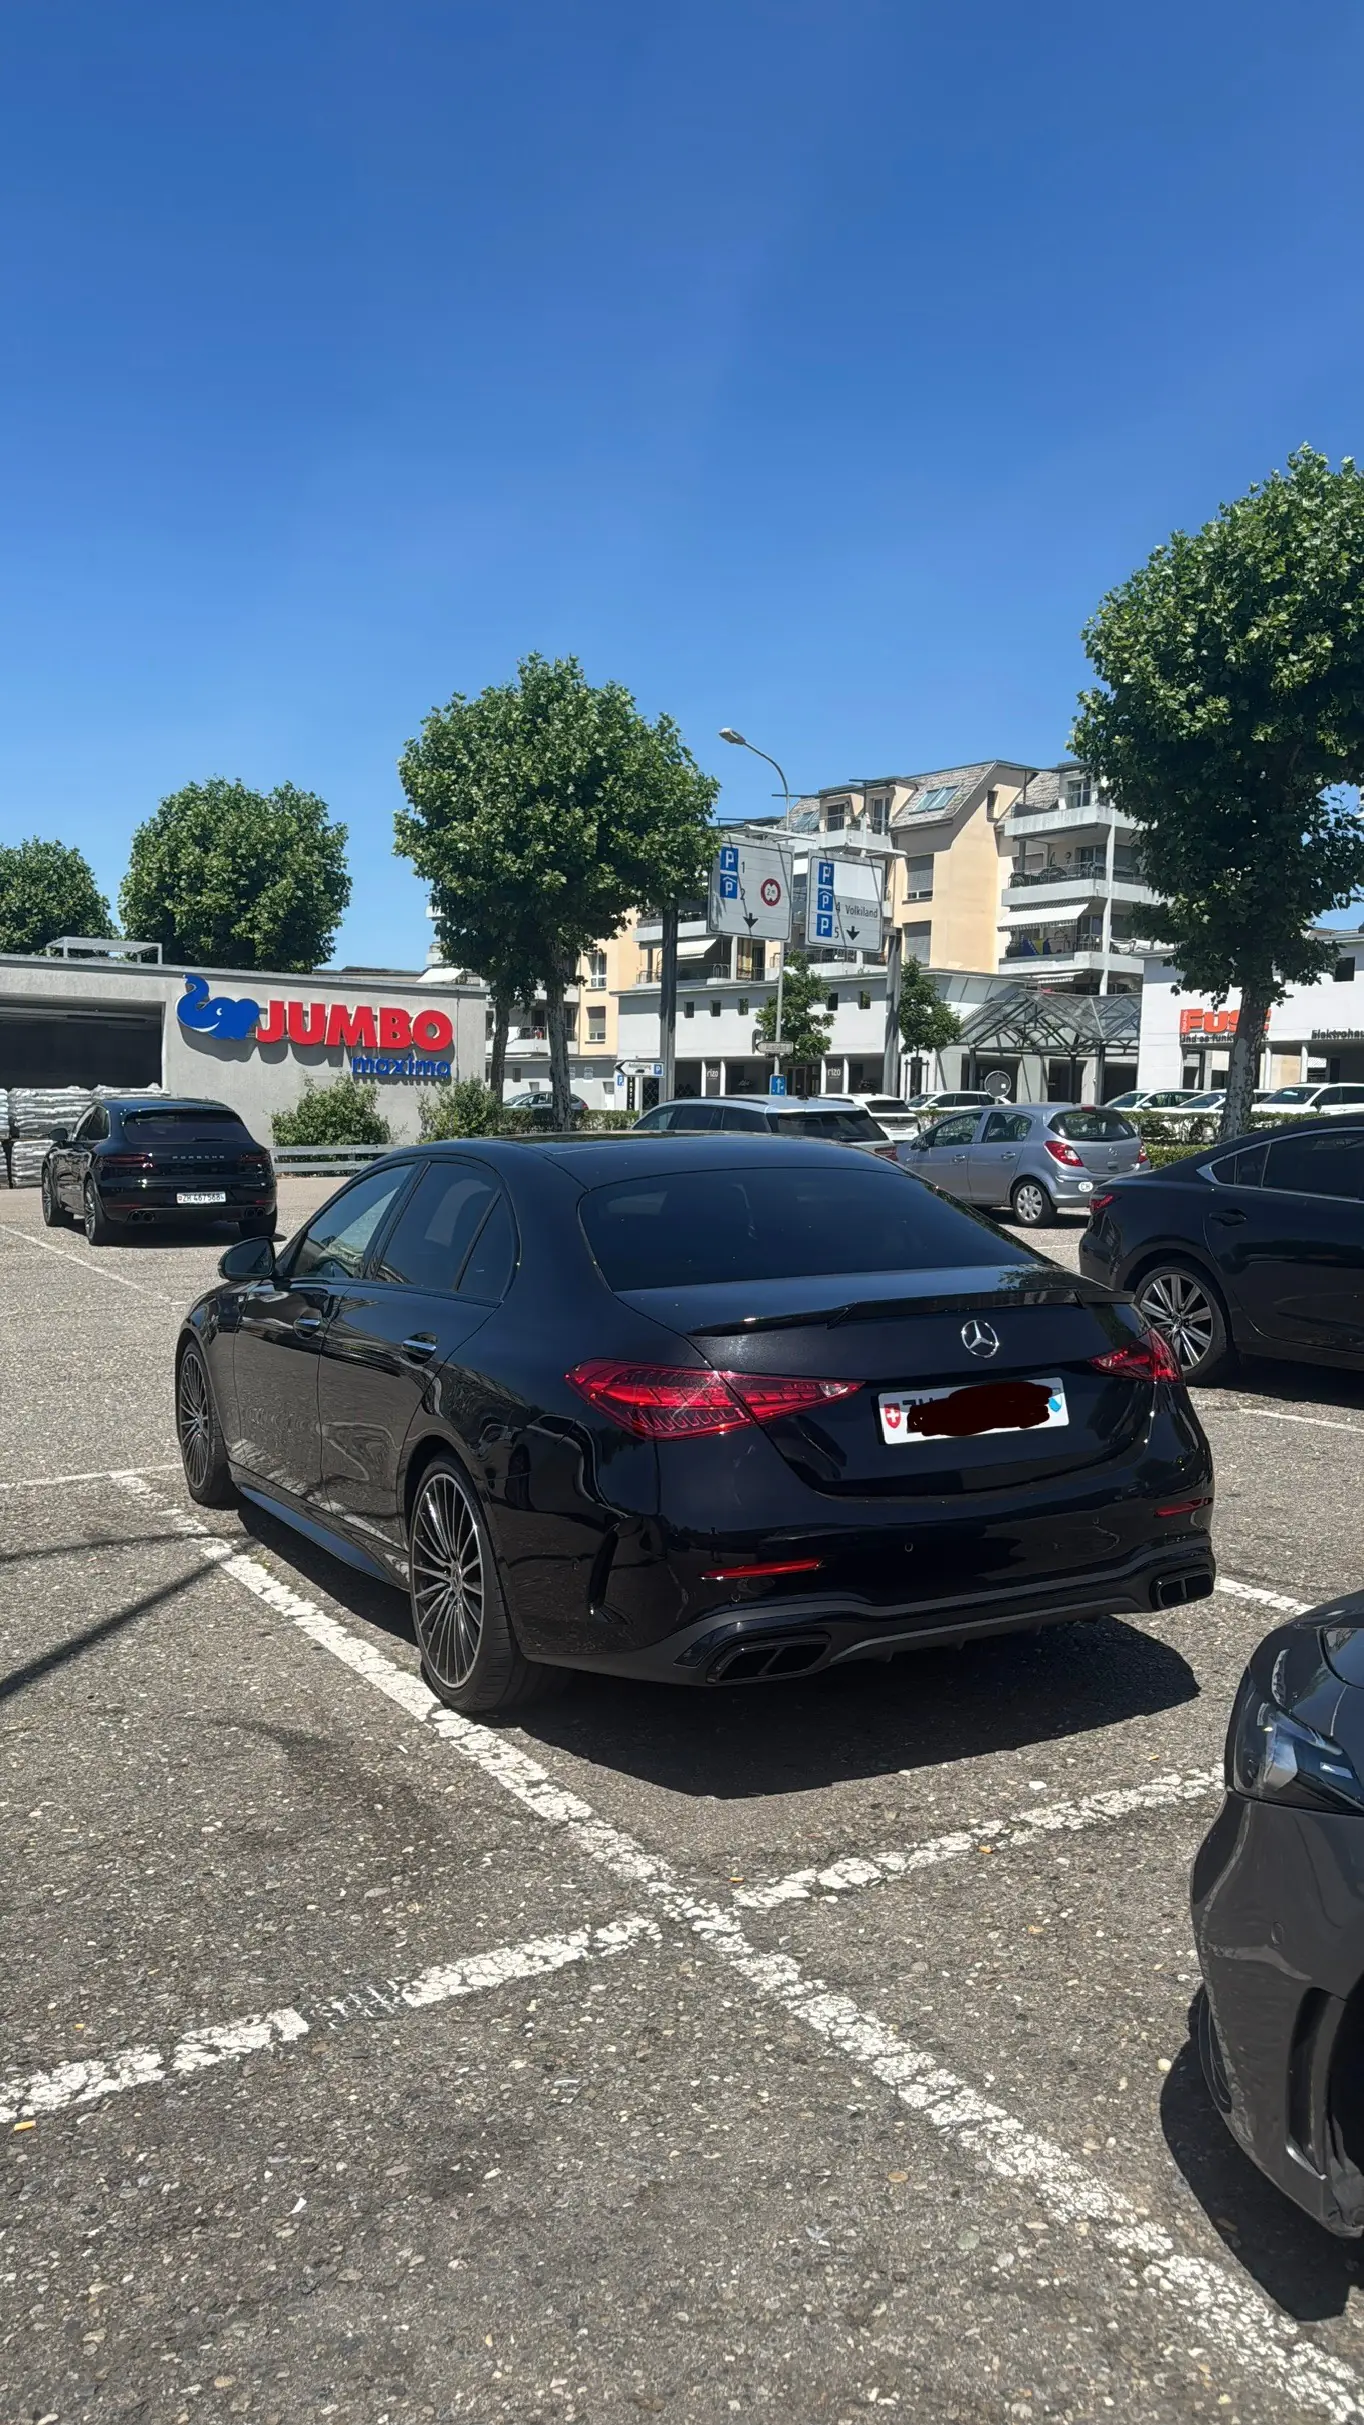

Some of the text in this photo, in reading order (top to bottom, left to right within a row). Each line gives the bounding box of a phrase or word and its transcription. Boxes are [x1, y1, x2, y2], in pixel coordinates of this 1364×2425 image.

[725, 851, 745, 873] P 1
[822, 866, 831, 883] P
[725, 881, 746, 900] P 2
[822, 894, 829, 908] P
[845, 904, 878, 918] Volkiland
[820, 917, 839, 939] P 5
[255, 1000, 453, 1052] JUMBO
[352, 1053, 451, 1077] maximo
[827, 1067, 841, 1076] rizo
